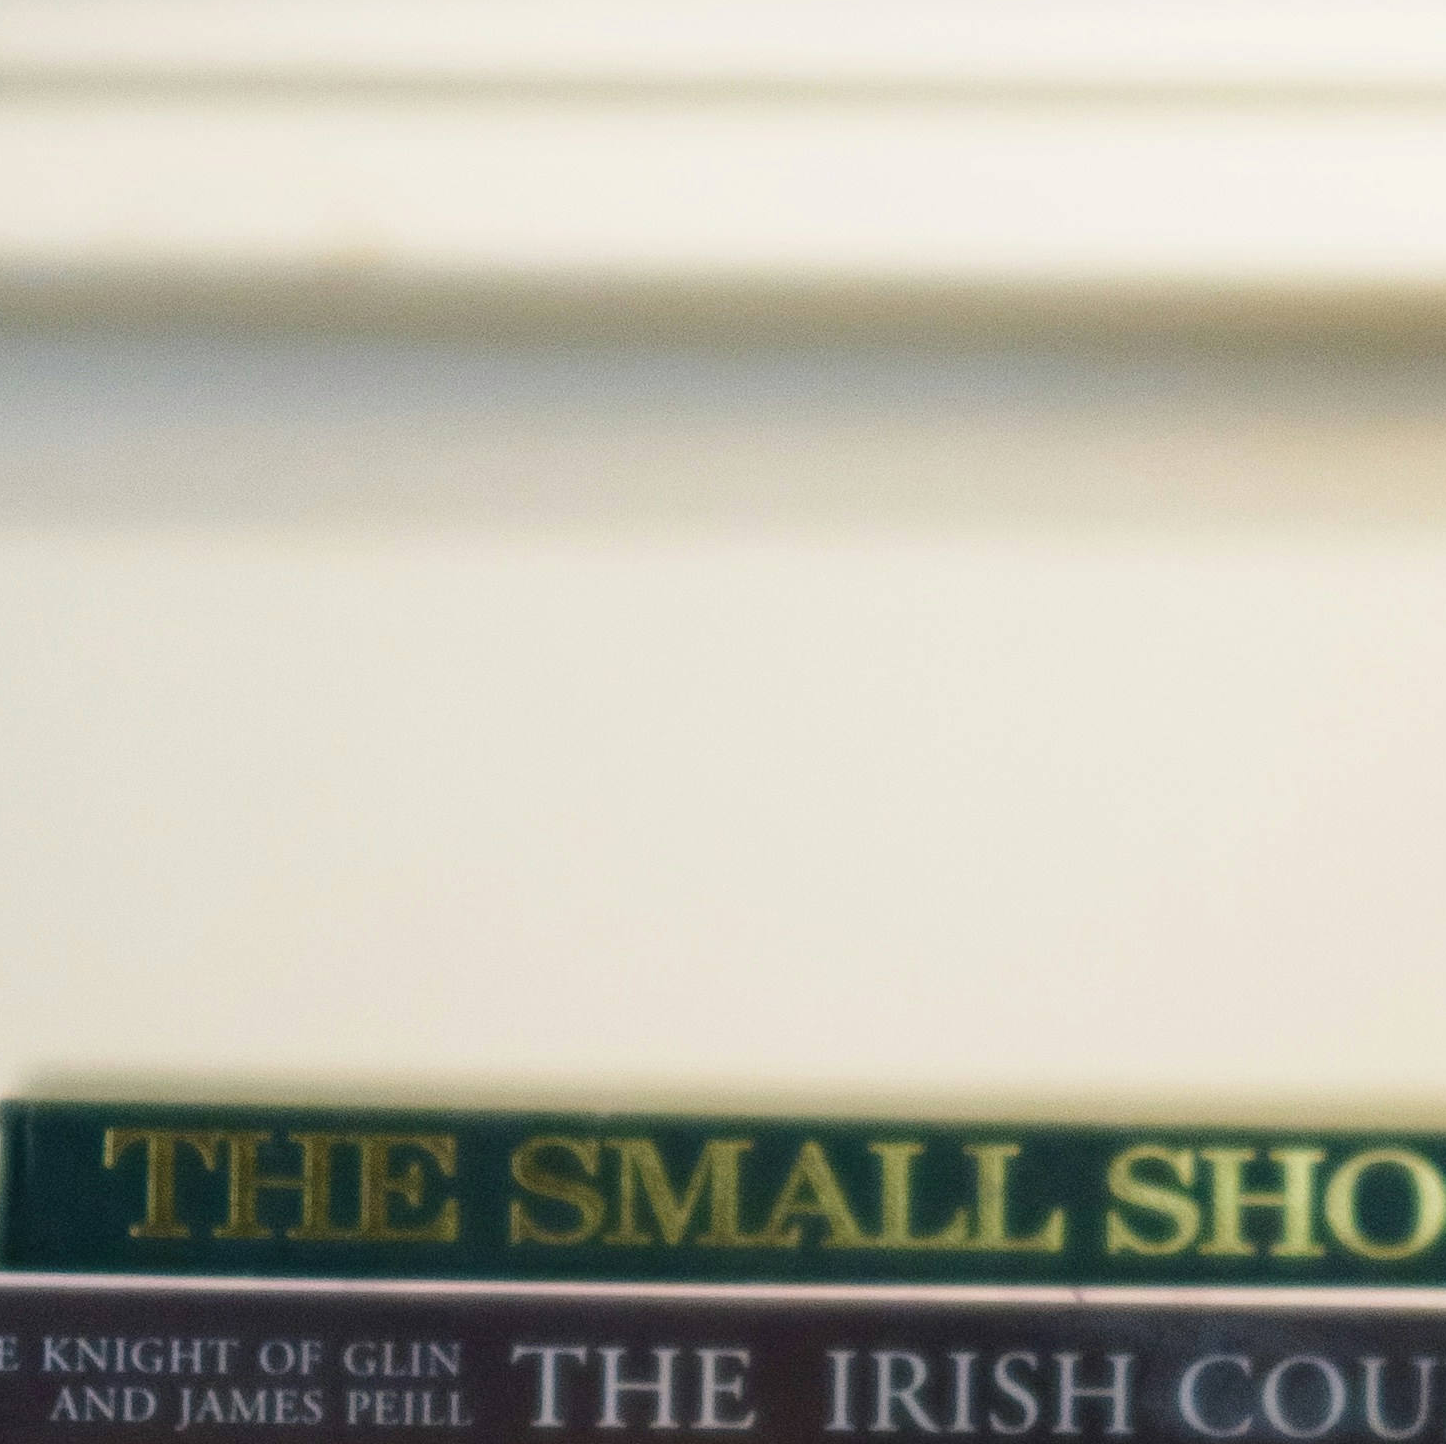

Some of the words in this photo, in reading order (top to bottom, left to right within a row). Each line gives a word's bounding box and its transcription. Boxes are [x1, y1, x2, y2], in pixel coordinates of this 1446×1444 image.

[101, 1126, 459, 1244] THE
[509, 1135, 1066, 1254] SMALL
[41, 1336, 239, 1376] KNIGHT
[258, 1339, 321, 1377] OF
[342, 1341, 462, 1379] GLIN
[511, 1344, 757, 1432] THE
[826, 1349, 1135, 1436] IRISH
[50, 1385, 158, 1424] AND
[176, 1387, 324, 1432] JAMES
[346, 1389, 473, 1428] PEILL
